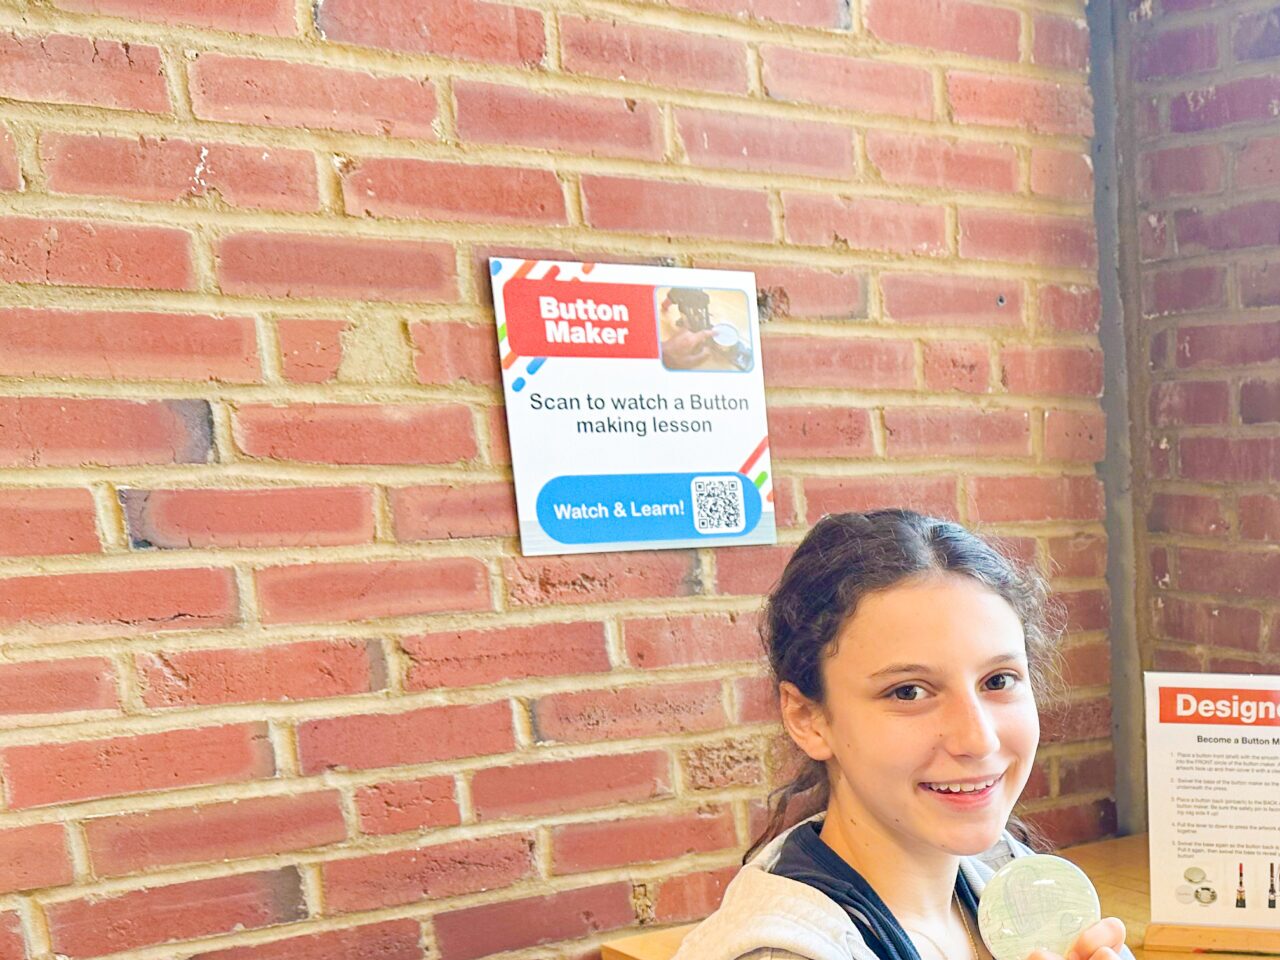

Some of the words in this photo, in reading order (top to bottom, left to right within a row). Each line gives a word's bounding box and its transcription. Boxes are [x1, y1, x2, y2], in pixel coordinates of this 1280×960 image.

[538, 296, 629, 322] Button
[545, 321, 629, 345] Maker
[529, 393, 581, 410] Scan
[586, 394, 606, 410] to
[611, 394, 668, 411] watch
[673, 398, 685, 411] a
[690, 394, 749, 412] Button
[576, 417, 647, 437] making
[653, 417, 713, 433] lesson
[553, 501, 609, 520] Watch
[613, 501, 627, 518] &
[631, 500, 685, 517] Learn!
[1197, 735, 1232, 744] Become
[1241, 737, 1270, 745] Button
